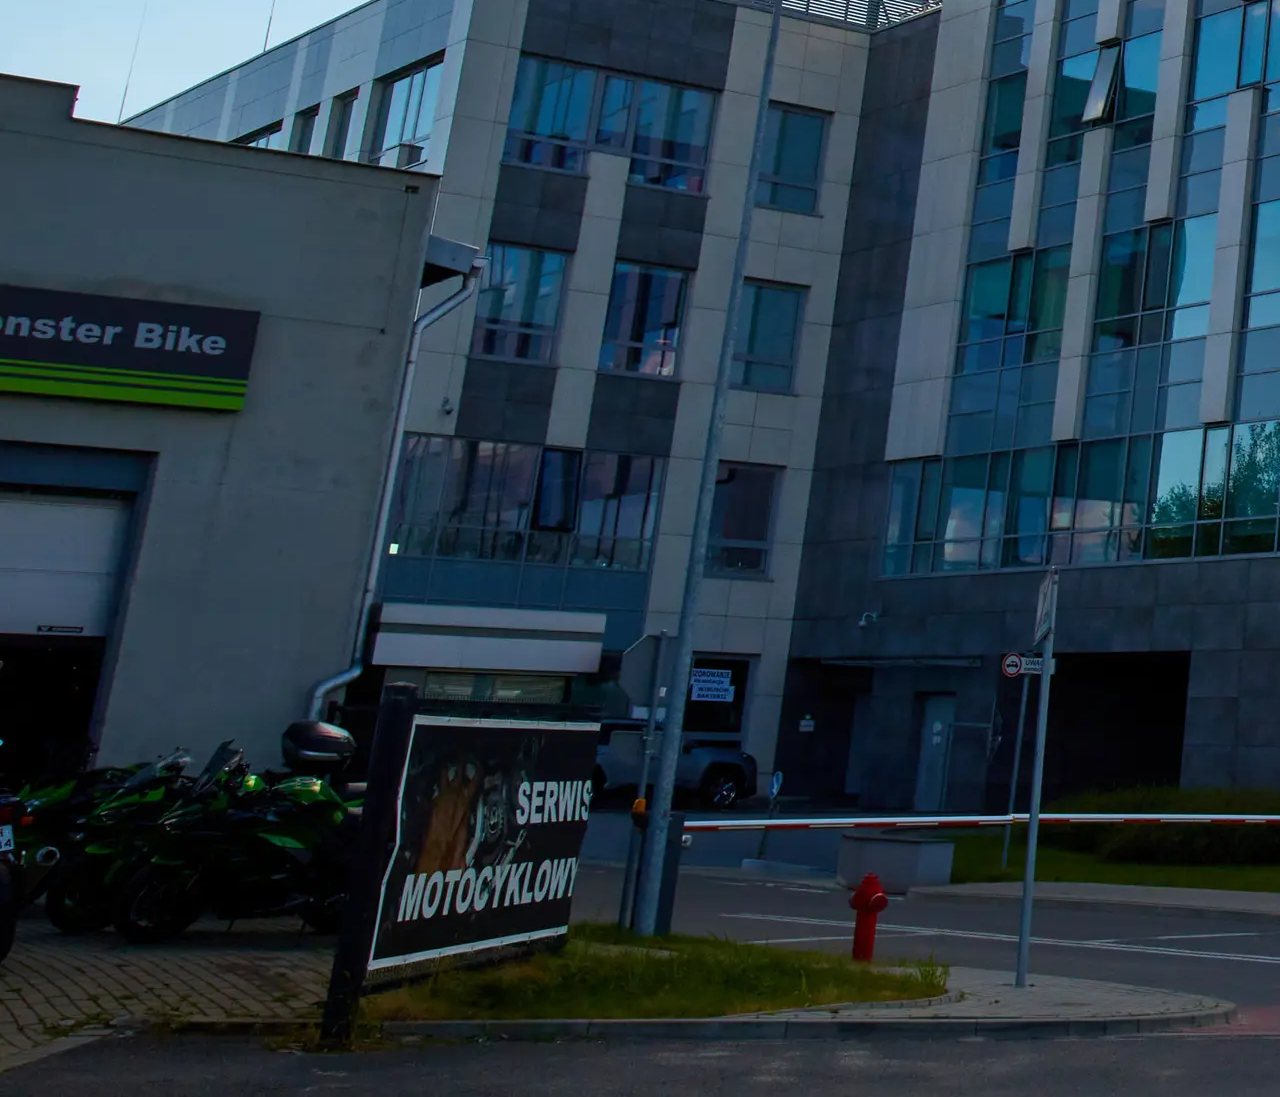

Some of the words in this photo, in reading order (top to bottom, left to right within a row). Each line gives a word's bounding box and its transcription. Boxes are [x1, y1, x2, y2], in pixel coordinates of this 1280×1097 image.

[0, 314, 122, 346] nster
[134, 321, 227, 356] Bike
[516, 779, 593, 826] SERWIS
[397, 856, 579, 923] MOTOCYKLOWY
